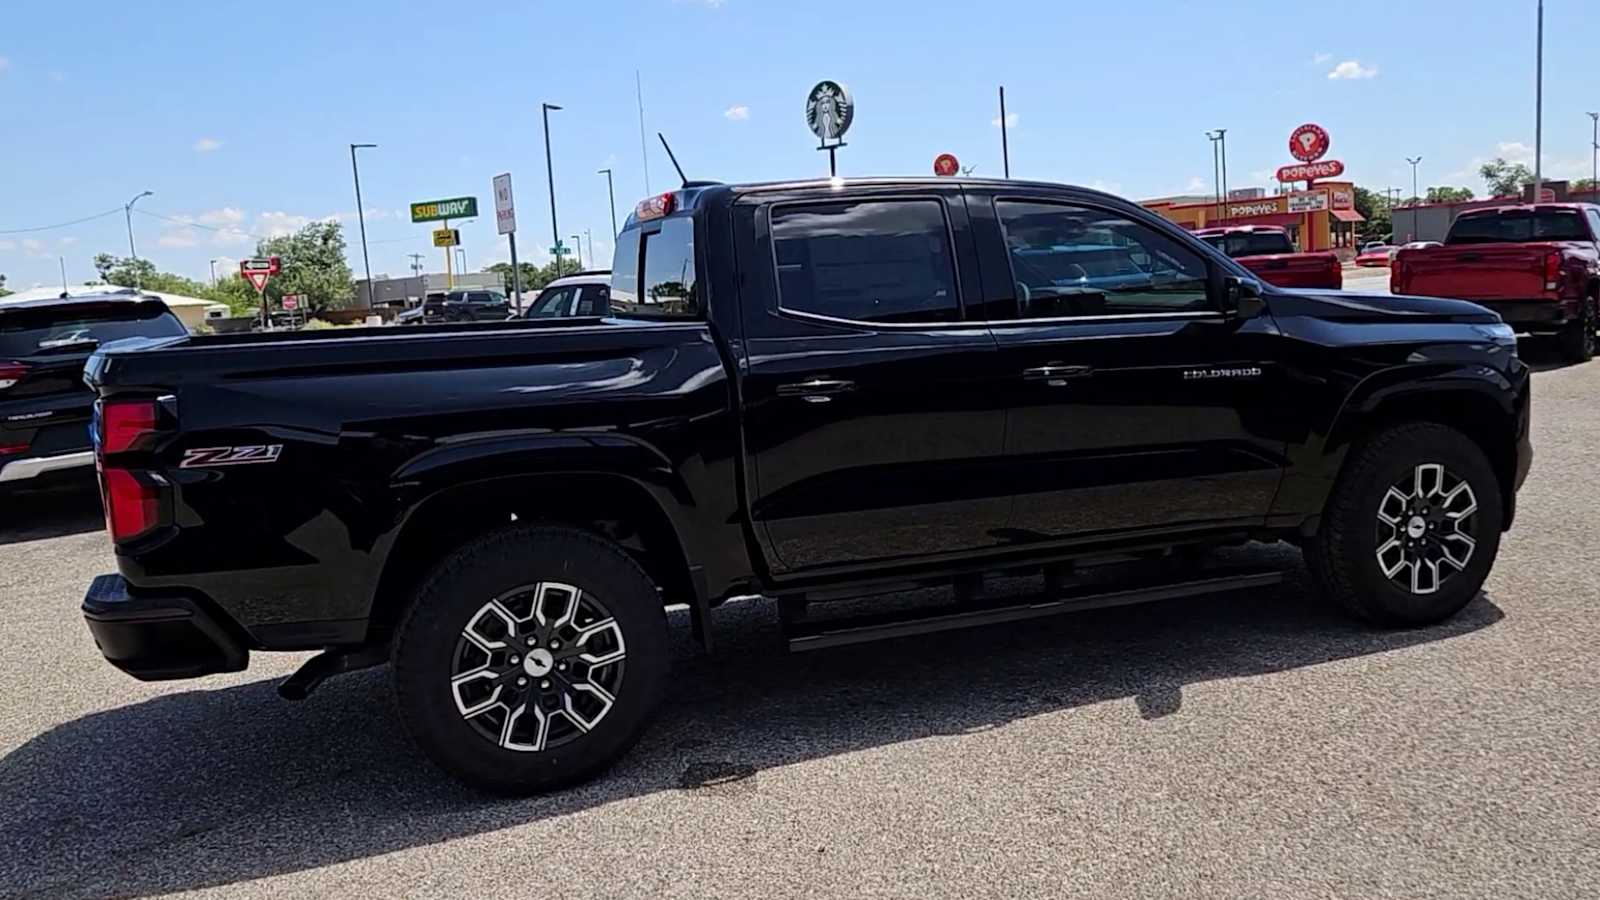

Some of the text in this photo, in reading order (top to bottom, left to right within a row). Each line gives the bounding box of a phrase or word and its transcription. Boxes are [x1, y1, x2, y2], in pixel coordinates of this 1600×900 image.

[1282, 161, 1337, 179] POPEYES
[414, 201, 468, 218] SUBWAY
[1231, 203, 1278, 216] POPEYES
[1183, 367, 1262, 380] COLORADO
[179, 444, 284, 468] Z71
